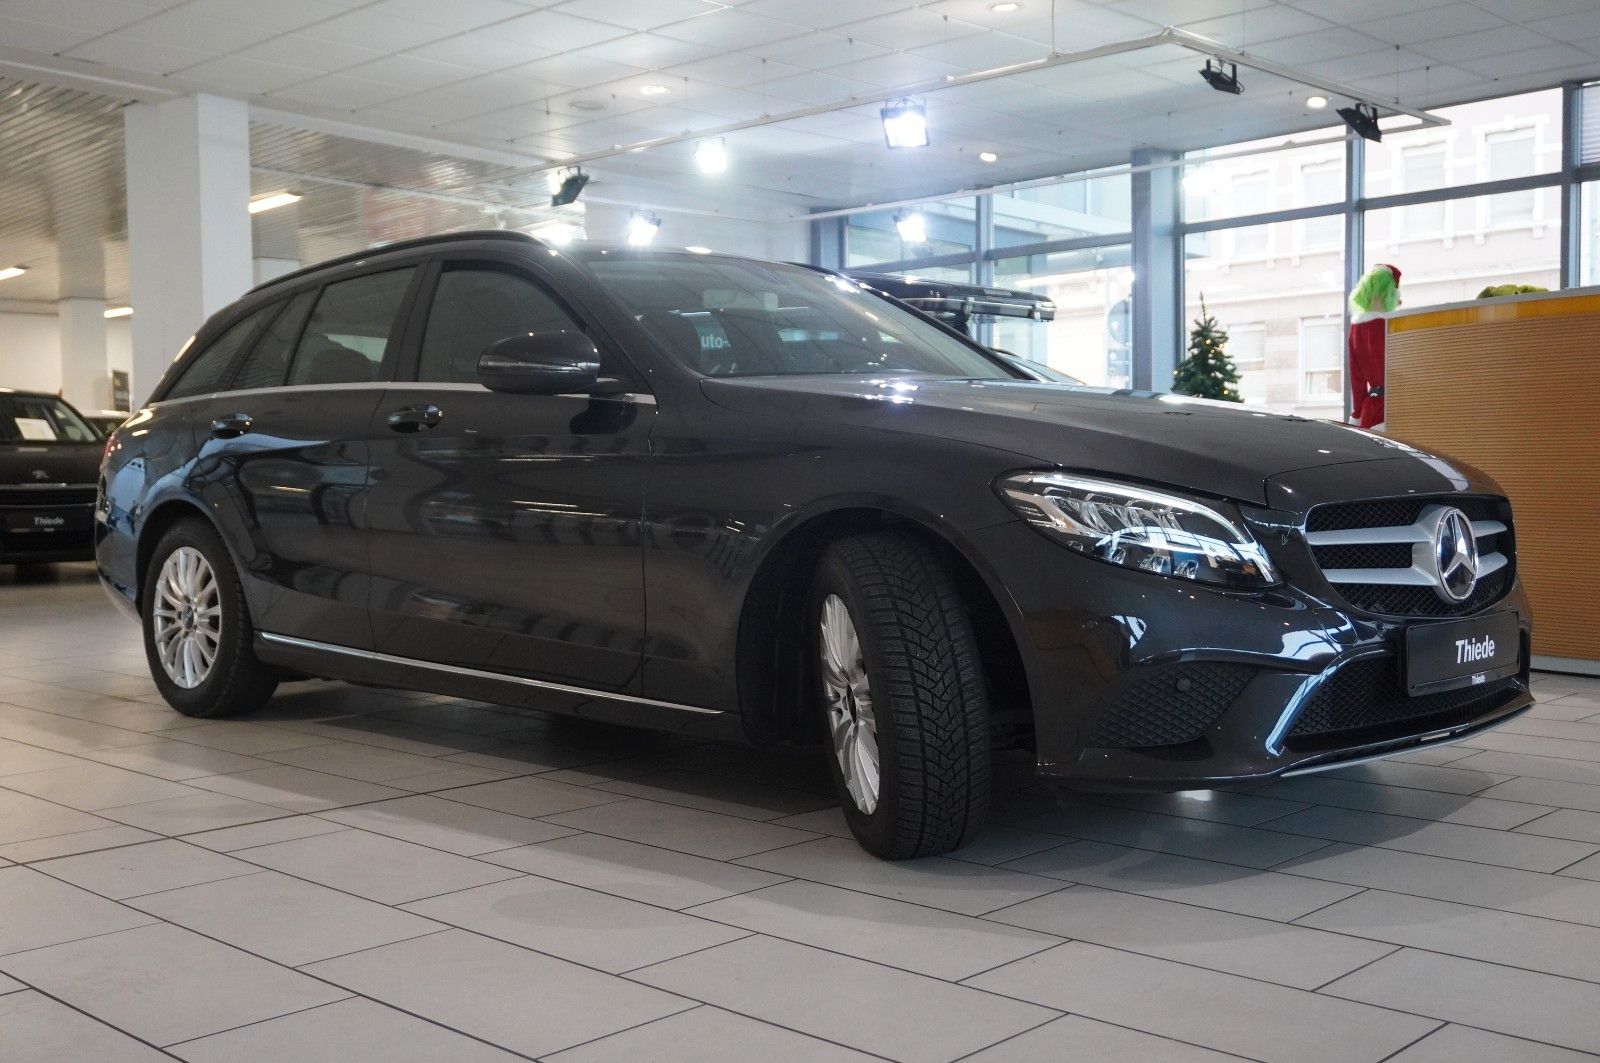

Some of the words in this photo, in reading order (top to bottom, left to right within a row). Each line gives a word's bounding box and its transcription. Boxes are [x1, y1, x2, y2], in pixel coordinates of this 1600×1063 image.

[34, 516, 64, 526] Thiede
[1455, 634, 1495, 664] Thiede
[1471, 674, 1486, 685] Thiede
